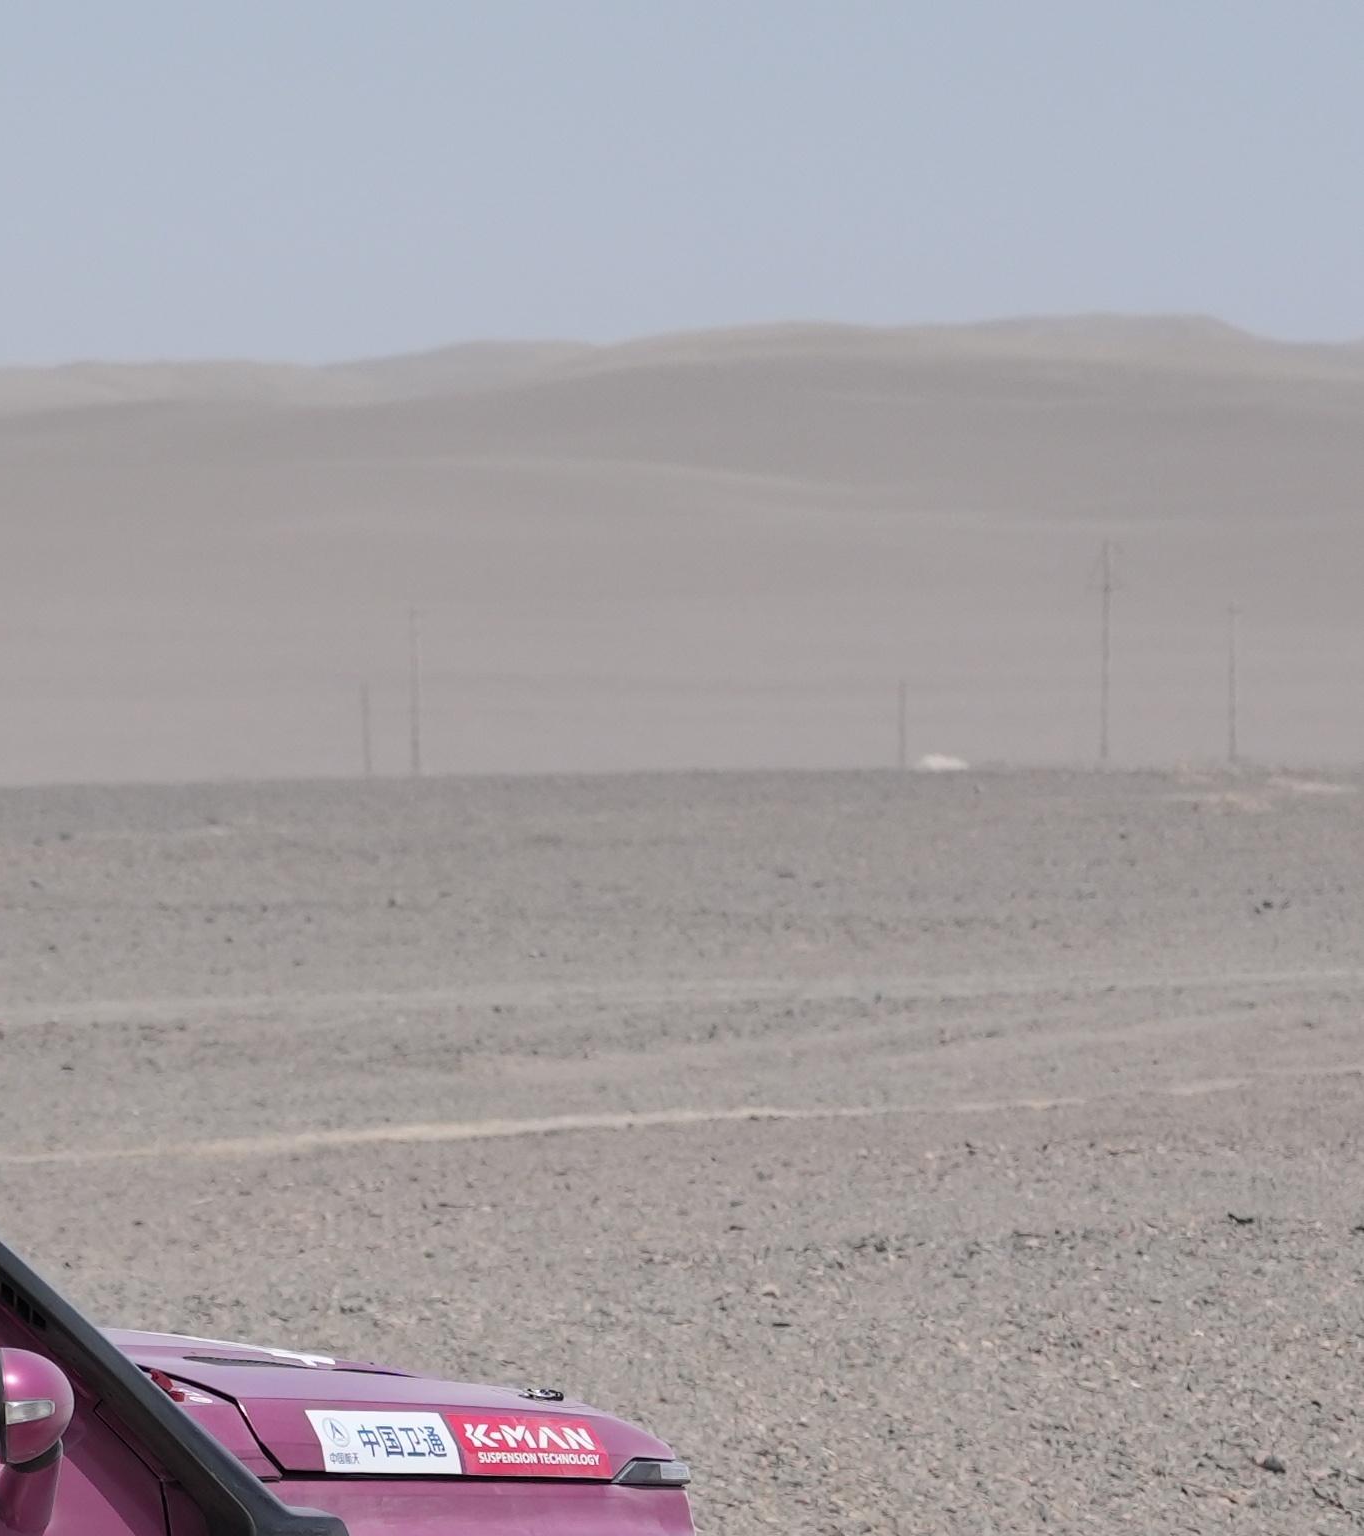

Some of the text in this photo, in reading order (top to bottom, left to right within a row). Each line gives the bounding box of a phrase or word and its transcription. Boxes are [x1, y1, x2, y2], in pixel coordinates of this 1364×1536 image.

[358, 1424, 448, 1459] 中国卫通
[462, 1422, 597, 1451] K-MAN
[478, 1451, 601, 1467] SUSPENSION TECHNOLOGY
